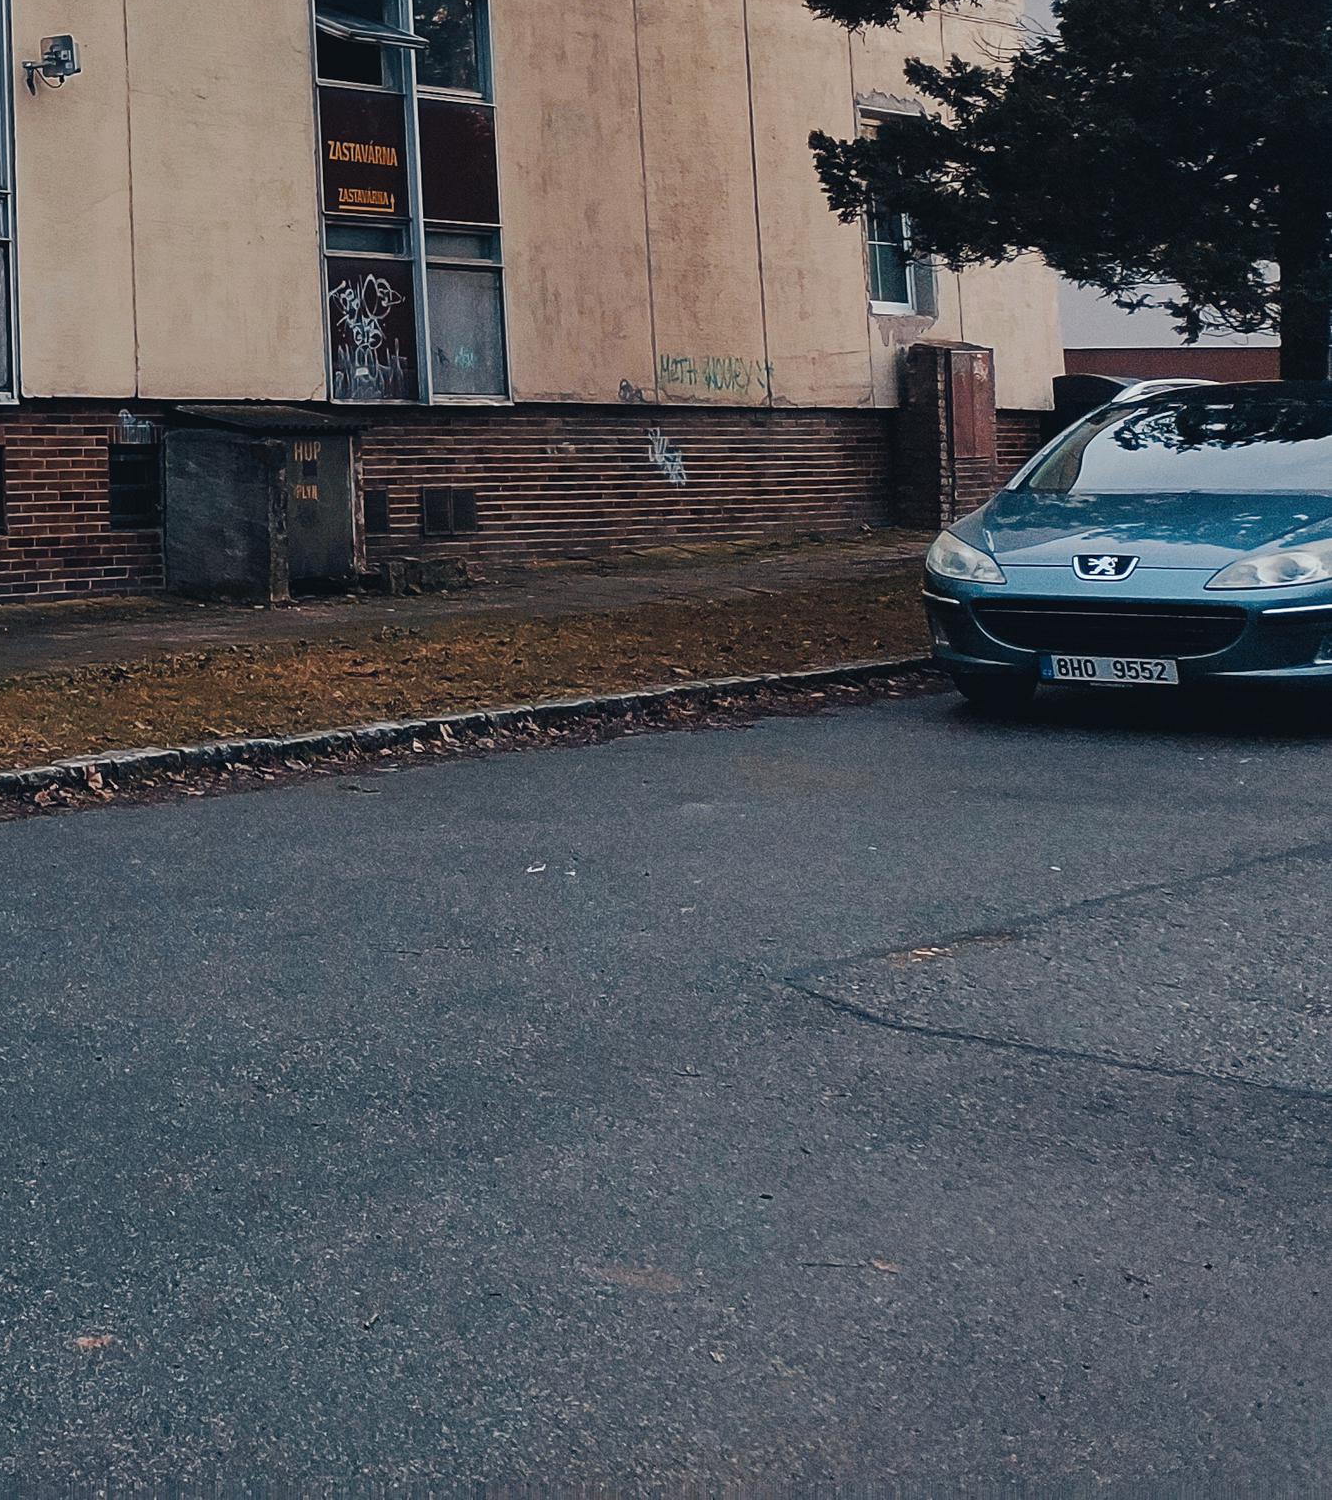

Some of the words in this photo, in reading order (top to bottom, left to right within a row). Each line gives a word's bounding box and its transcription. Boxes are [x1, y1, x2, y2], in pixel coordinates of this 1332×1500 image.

[328, 140, 399, 167] ZASTAVÁRNA
[338, 187, 389, 206] ZASTAVÁRNA
[294, 441, 322, 462] HUP
[1112, 660, 1169, 681] 9552
